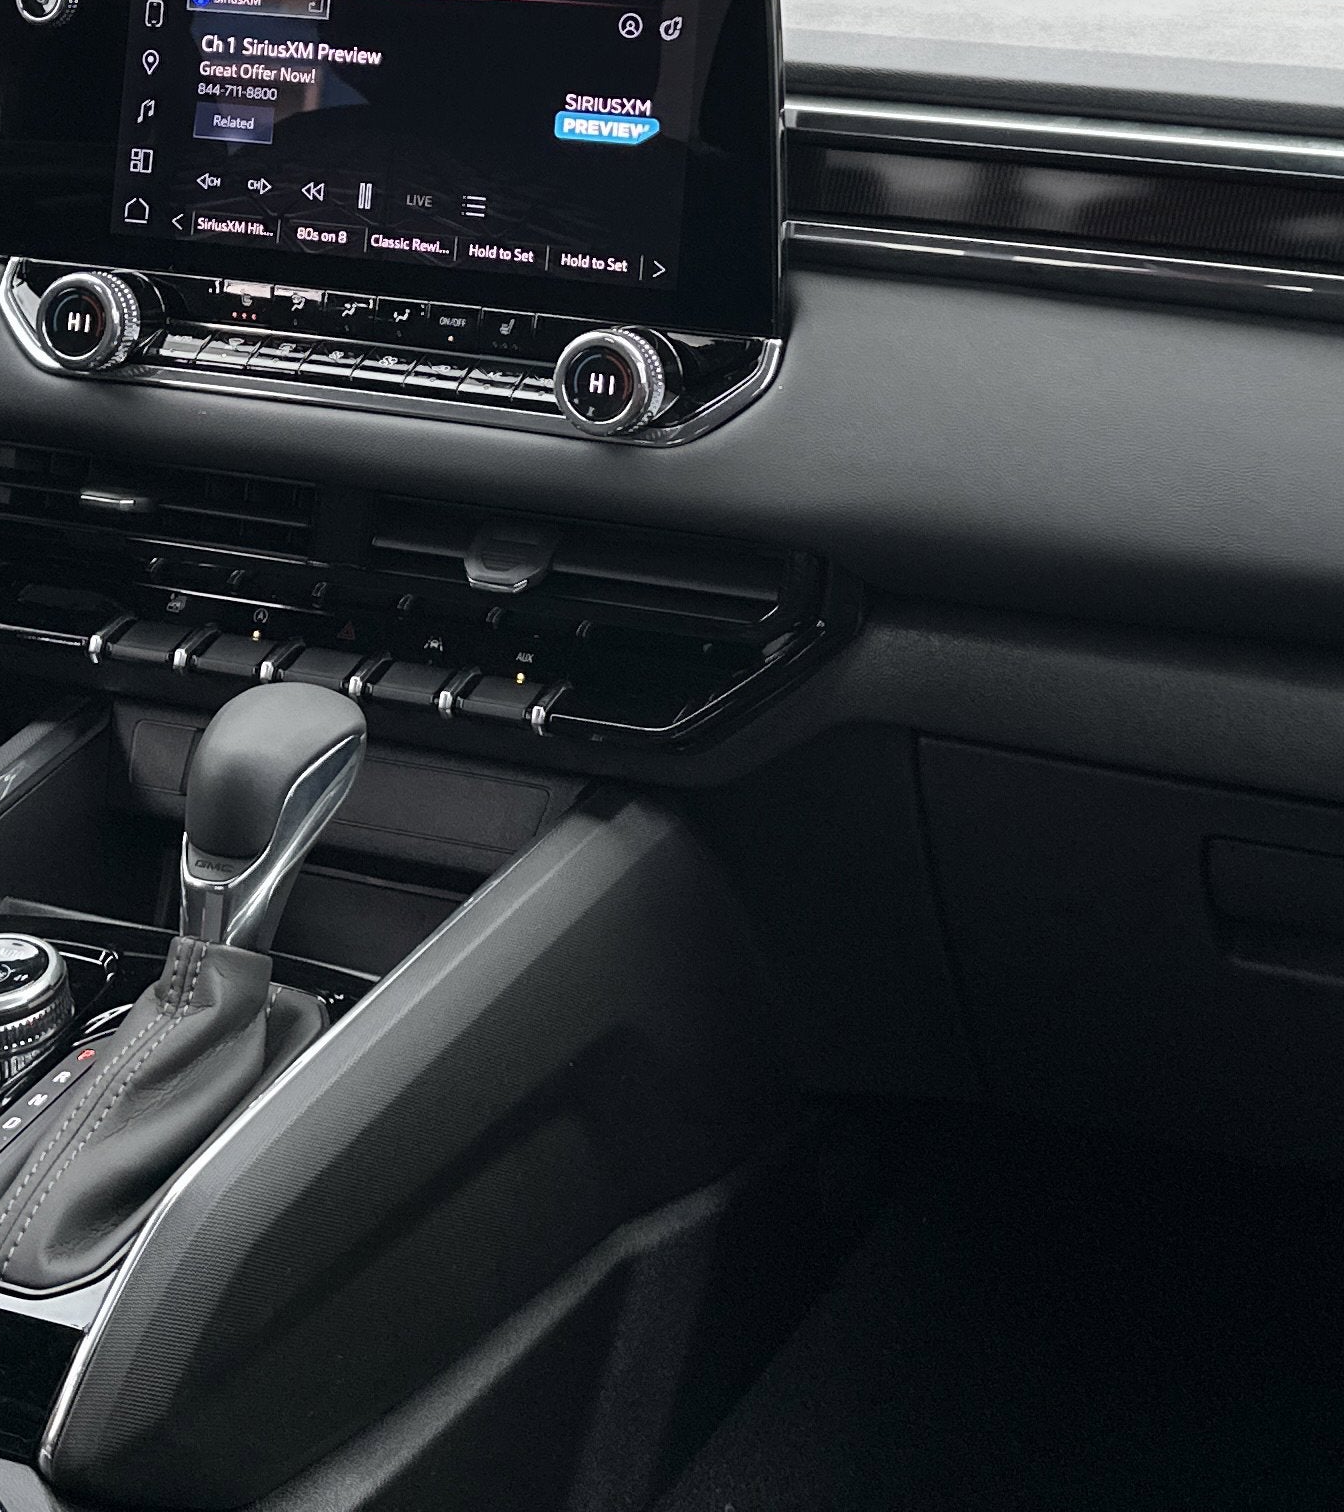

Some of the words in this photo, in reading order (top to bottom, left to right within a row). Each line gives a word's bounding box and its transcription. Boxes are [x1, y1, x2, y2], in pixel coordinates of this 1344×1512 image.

[201, 35, 224, 54] Ch
[227, 37, 235, 54] 1
[242, 38, 314, 60] SiriusXM
[317, 44, 383, 65] Preview
[199, 61, 237, 78] Great
[240, 64, 276, 81] Offer
[279, 67, 316, 84] Now!
[197, 82, 278, 101] 844-711-8800
[564, 93, 653, 117] SIRIUSXM
[213, 114, 255, 131] Related
[563, 117, 650, 139] PREVIEW
[406, 194, 433, 208] LIVE
[197, 217, 246, 235] SiriusXM
[296, 227, 320, 242] 80s
[321, 231, 337, 243] on
[370, 234, 410, 251] Classic
[468, 244, 497, 259] Hold
[499, 248, 512, 260] to
[513, 248, 534, 264] Set
[560, 253, 590, 269] Hold
[592, 257, 605, 270] to
[606, 257, 628, 272] Set
[67, 311, 91, 334] HI
[439, 315, 467, 328] ON/OFF
[588, 372, 615, 396] HI
[516, 651, 534, 664] AUX
[195, 858, 237, 874] GMC
